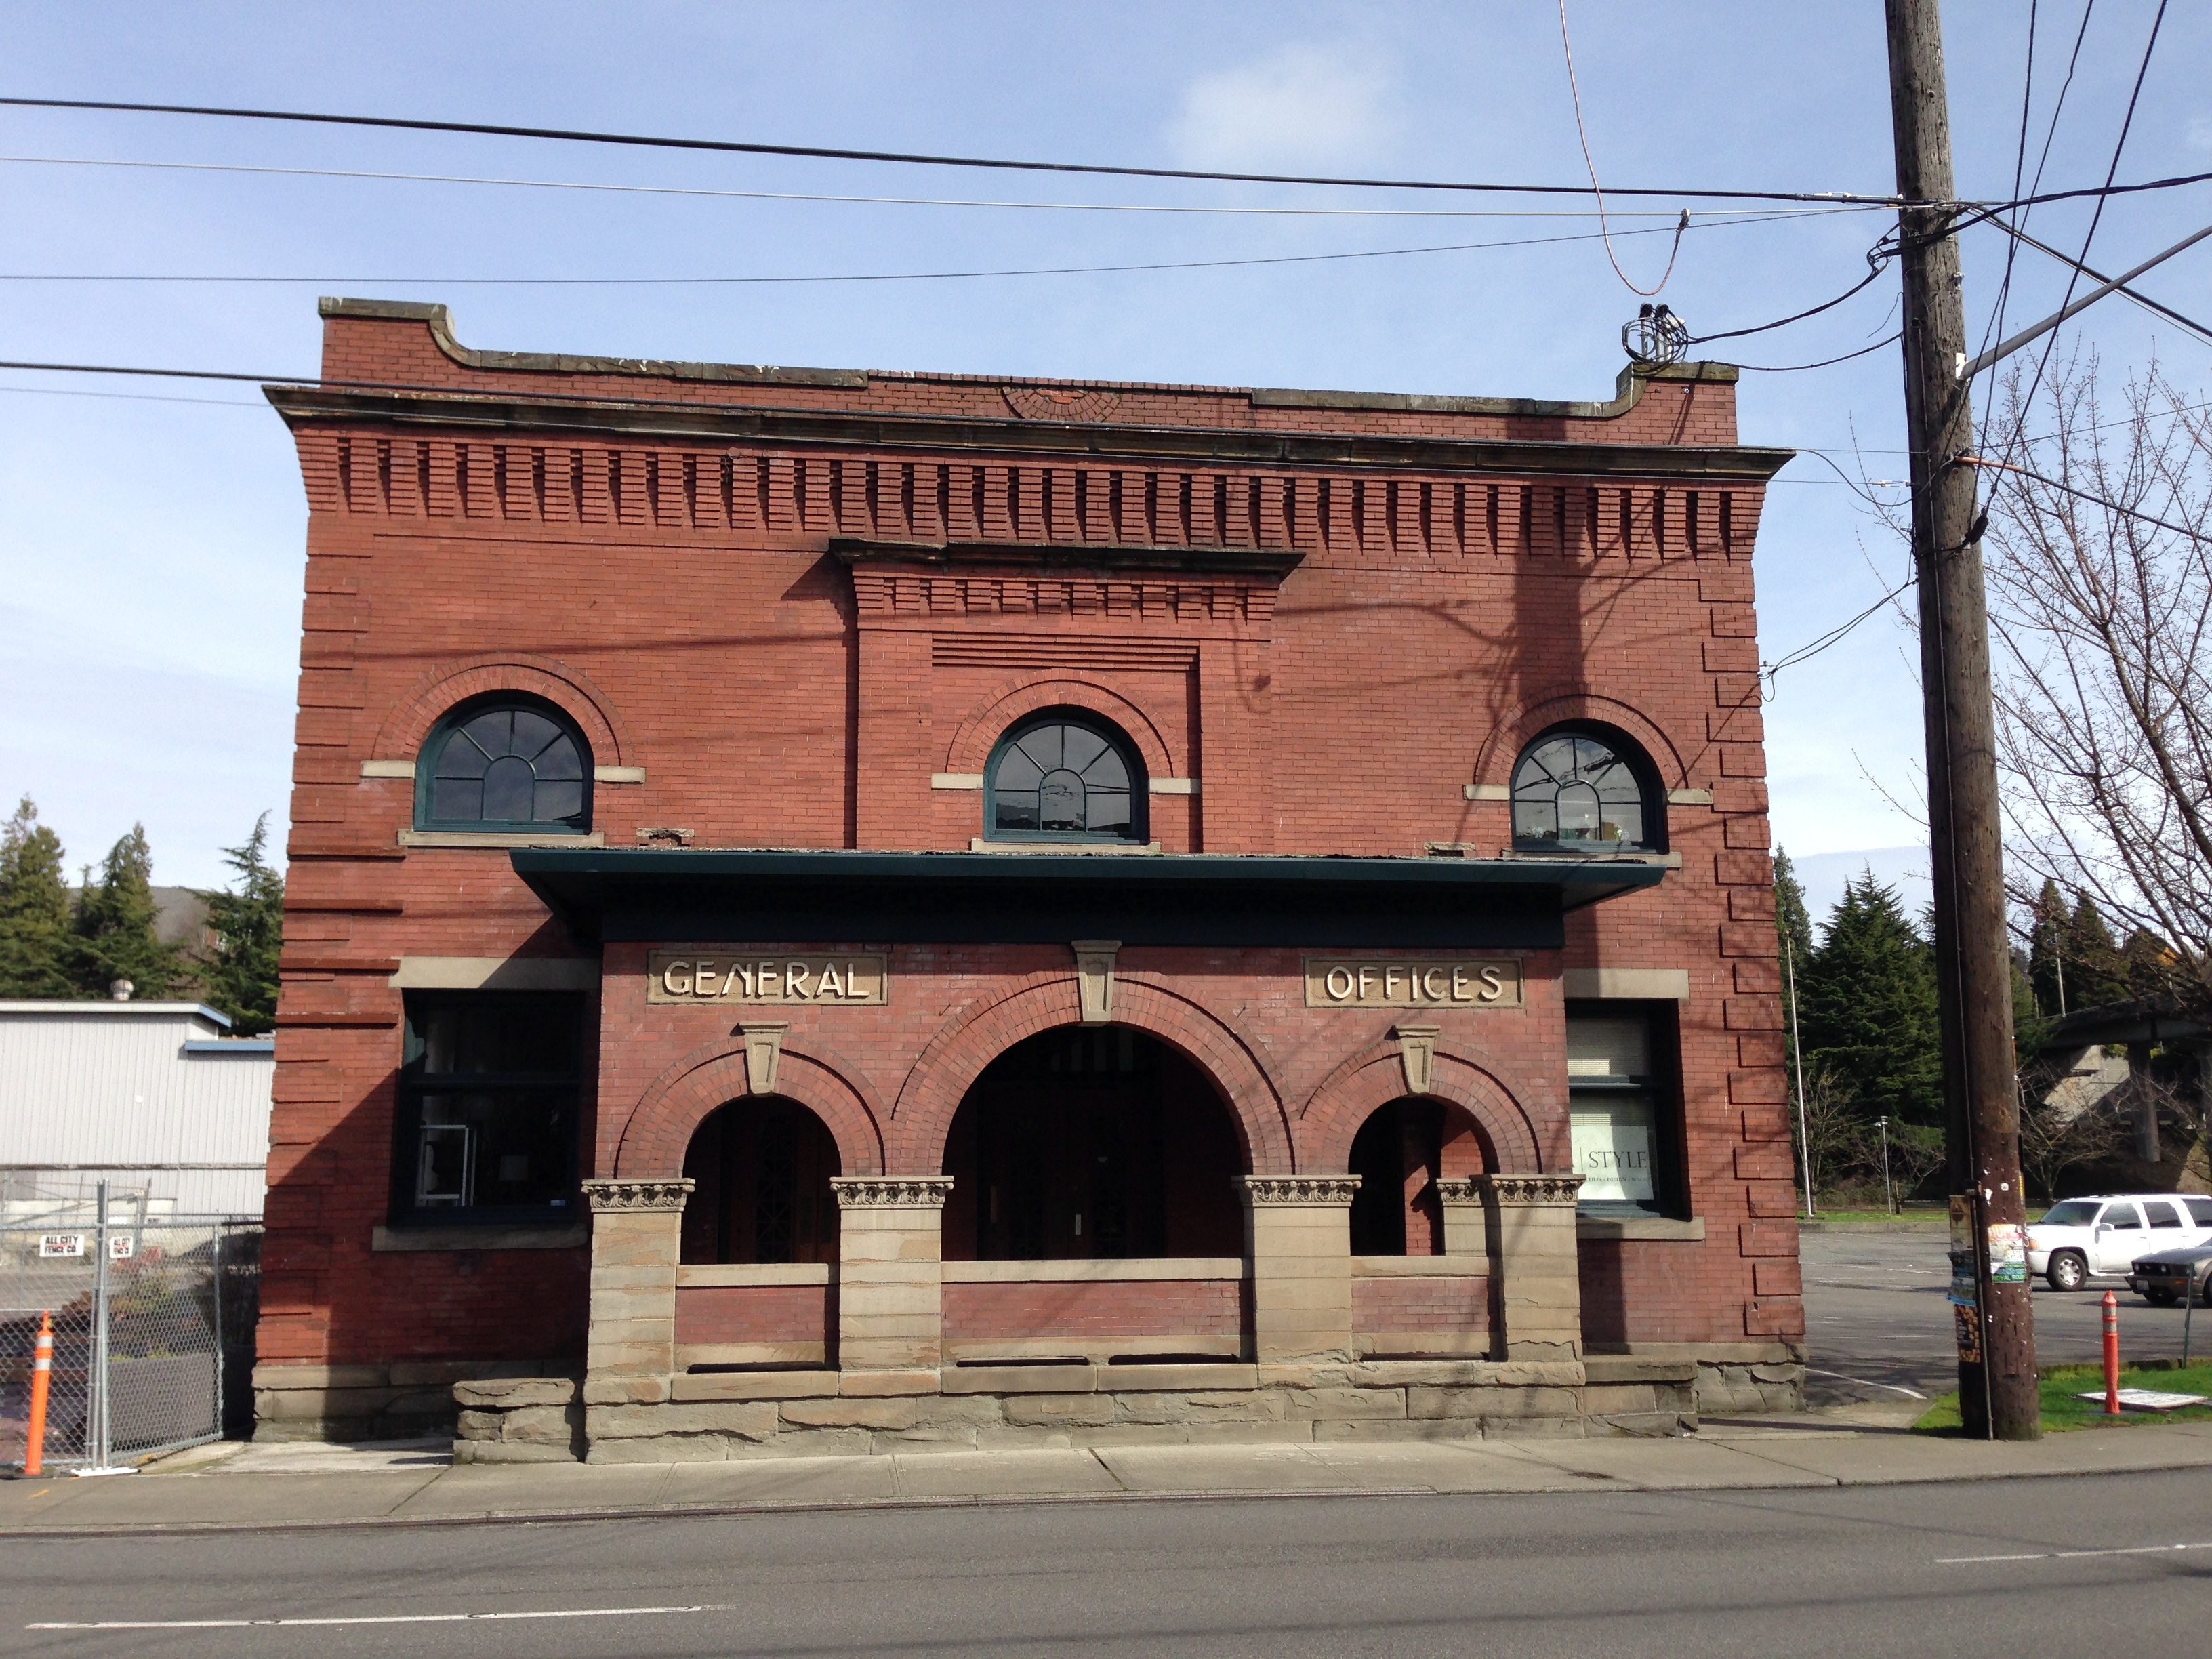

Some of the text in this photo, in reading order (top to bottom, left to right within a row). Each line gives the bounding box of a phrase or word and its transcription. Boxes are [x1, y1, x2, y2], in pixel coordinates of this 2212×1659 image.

[663, 960, 870, 998] GENERAL
[1326, 965, 1504, 1000] OFFICES
[1589, 1151, 1647, 1168] STYLE
[45, 1235, 79, 1244] ALL CITY
[45, 1246, 64, 1254] FENCE
